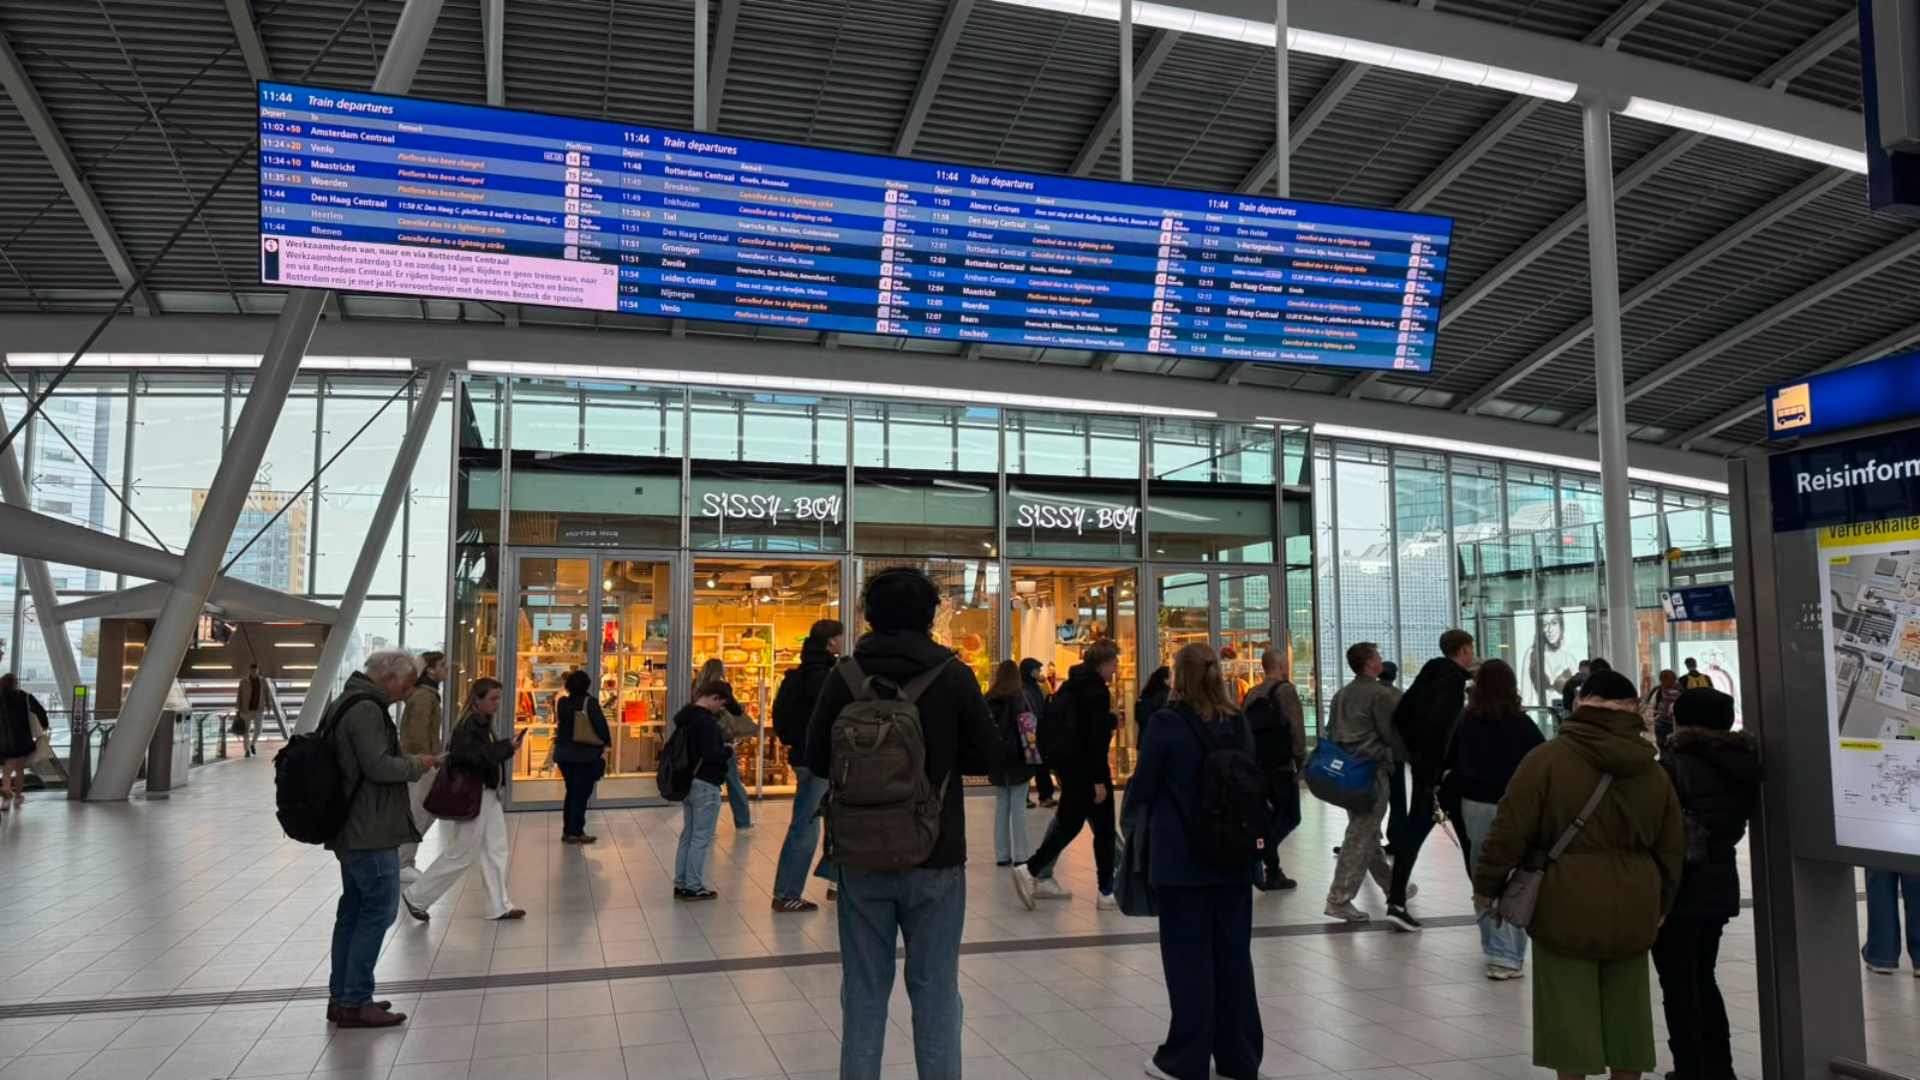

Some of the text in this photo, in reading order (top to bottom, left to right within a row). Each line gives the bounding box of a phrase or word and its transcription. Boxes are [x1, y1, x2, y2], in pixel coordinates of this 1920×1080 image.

[263, 91, 393, 115] 11:44 Train departures
[262, 109, 286, 117] Depart
[262, 122, 284, 131] 11:02
[286, 125, 301, 133] +50
[311, 127, 358, 139] Amsterdam
[360, 132, 395, 143] Centraal
[624, 132, 738, 154] 11:44 Train departures
[263, 139, 285, 148] 11:24
[286, 142, 301, 150] +20
[311, 144, 334, 154] Venlo
[457, 160, 485, 169] changed
[263, 156, 285, 165] 11:34
[286, 158, 301, 166] +10
[311, 160, 355, 172] Maastricht
[457, 176, 485, 185] changed
[623, 161, 735, 181] 11:48 Rotterdam Centraal
[263, 172, 285, 181] 11:35
[311, 177, 347, 188] Woerden
[664, 182, 700, 193] Breukelen
[936, 170, 1034, 190] 11:44 Train departures
[263, 189, 285, 198] 11:44
[311, 193, 327, 202] Den
[330, 195, 351, 206] Haag
[355, 197, 387, 207] Centraal
[622, 193, 700, 208] 11:49 Enkhuizen
[264, 205, 342, 220] 11:44 Heerlen
[622, 209, 641, 217] 11:50
[663, 213, 677, 221] Tiel
[970, 202, 992, 211] Almere
[994, 205, 1020, 214] Centrum
[1208, 199, 1297, 216] 11:44 Train departures
[264, 222, 342, 235] 11:44 Rhenen
[969, 216, 981, 224] Den
[983, 218, 999, 227] Haag
[1000, 220, 1026, 229] Centraal
[621, 224, 729, 241] 11:51 Den Haag Centraal
[286, 240, 359, 252] Werkzaamheden
[429, 252, 472, 262] Rotterdam
[474, 256, 509, 265] Centraal
[621, 239, 699, 255] 11:51 Groningen
[966, 245, 1026, 257] Rotterdam Centraal
[286, 251, 352, 263] Werkzaamheden
[355, 258, 390, 267] zaterdag
[417, 263, 444, 272] zondag
[477, 267, 500, 276] Rijden
[534, 273, 561, 281] treinen
[621, 255, 686, 268] 11:51 Zwolle
[965, 259, 998, 269] Rotterdam
[999, 262, 1025, 271] Centraal
[313, 264, 355, 274] Rotterdam
[406, 272, 428, 280] rijden
[431, 274, 457, 282] bussen
[511, 281, 545, 289] trajecten
[558, 285, 583, 293] binnen
[620, 270, 716, 285] 11:54 Leiden Centraal
[964, 274, 988, 282] Arnhem
[990, 275, 1016, 284] Centraal
[286, 273, 329, 283] Rotterdam
[348, 278, 355, 286] je
[376, 280, 383, 288] je
[513, 291, 538, 299] Bezoek
[620, 285, 694, 300] 11:54 Nijmegen
[963, 287, 996, 296] Maastricht
[619, 300, 681, 313] 11:54 Venlo
[962, 302, 989, 310] Woerden
[1797, 459, 1920, 494] Reisinform
